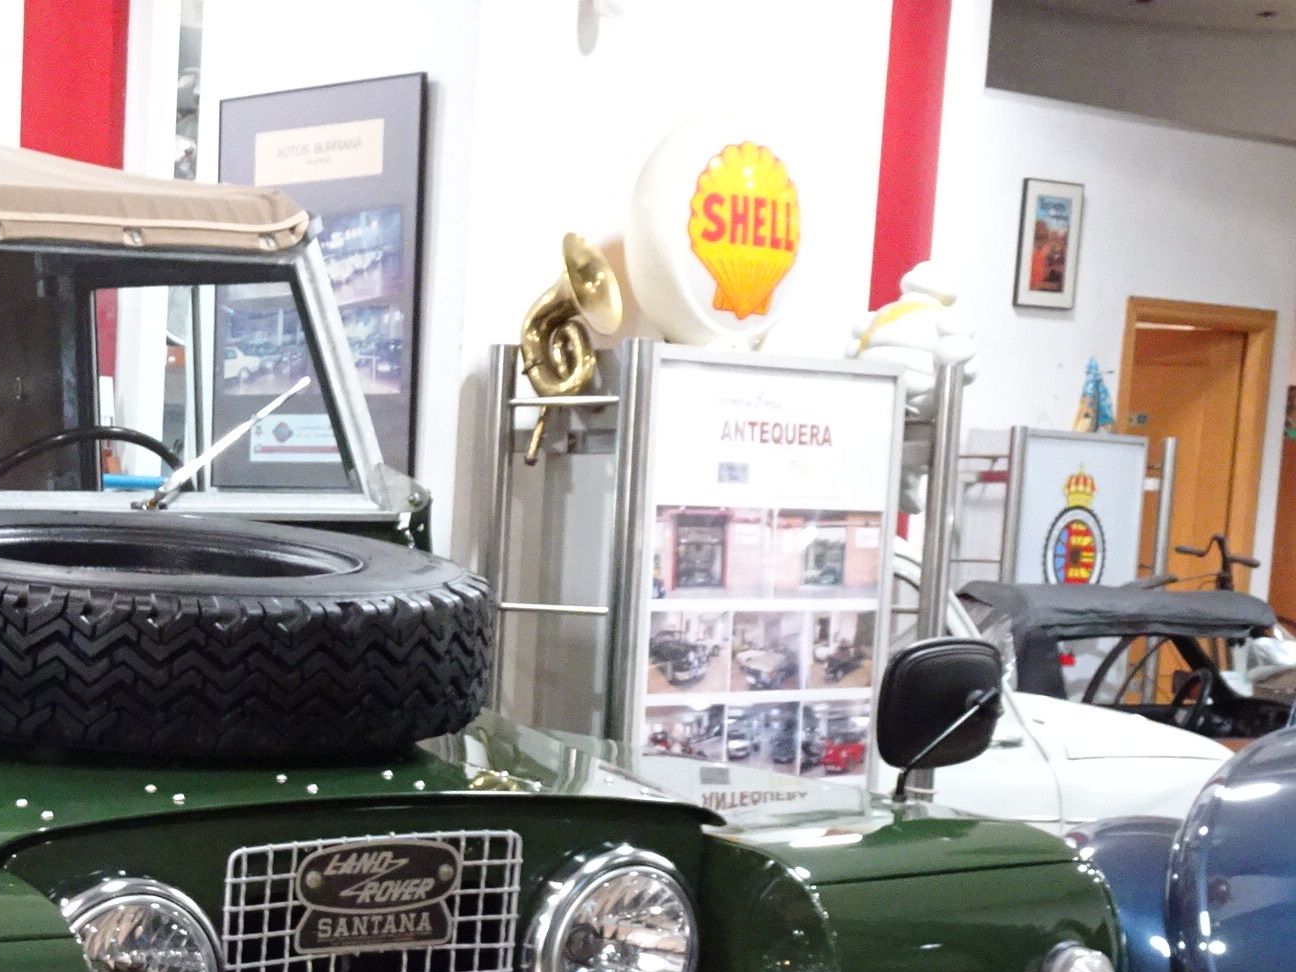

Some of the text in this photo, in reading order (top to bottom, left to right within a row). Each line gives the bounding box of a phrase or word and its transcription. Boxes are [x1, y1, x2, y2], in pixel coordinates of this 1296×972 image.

[701, 192, 795, 252] SHELL
[721, 419, 832, 447] ANTEQUERA
[323, 850, 396, 876] LAND
[356, 877, 436, 904] ROVER
[317, 911, 433, 939] SANTANA
